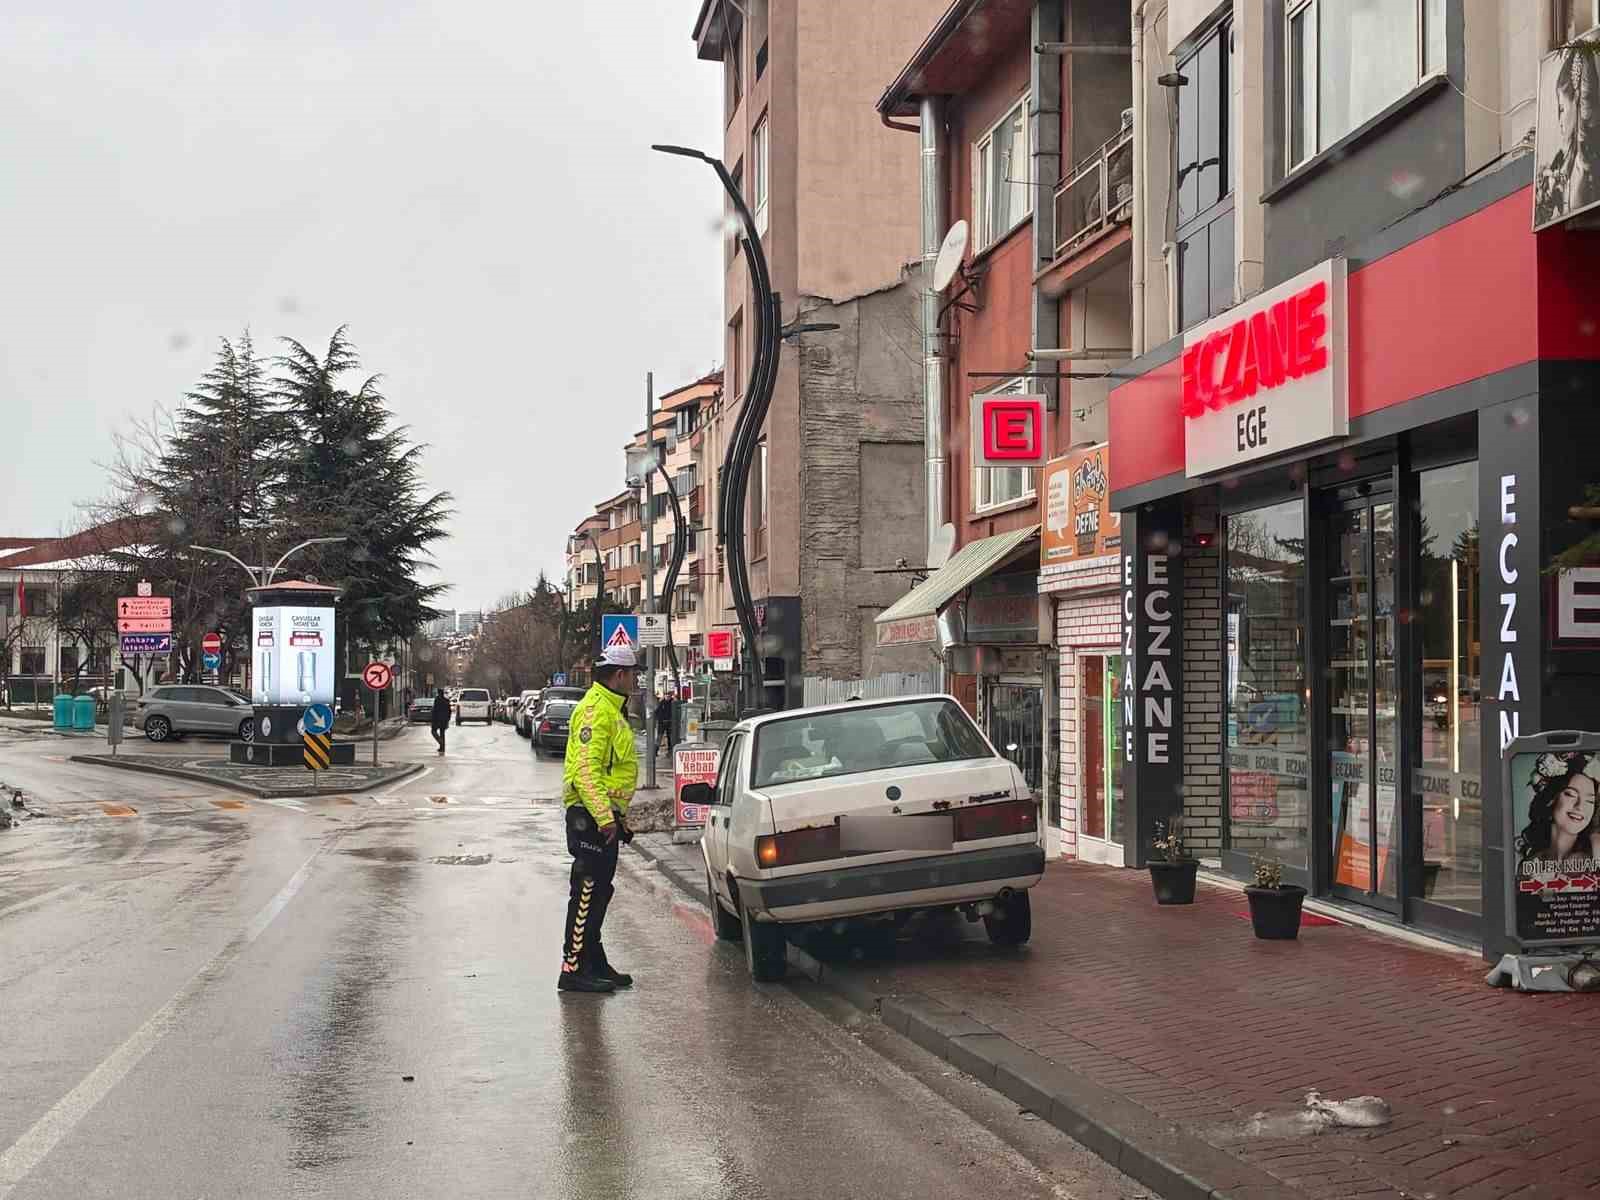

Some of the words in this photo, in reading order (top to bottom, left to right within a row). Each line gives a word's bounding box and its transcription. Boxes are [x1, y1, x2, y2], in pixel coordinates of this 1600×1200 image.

[1182, 281, 1327, 419] ECZANE
[996, 411, 1029, 449] E
[1237, 406, 1268, 452] EGE
[1075, 510, 1100, 536] DEFNE
[1124, 555, 1134, 762] ECZANE
[1142, 555, 1173, 763] ECZANE
